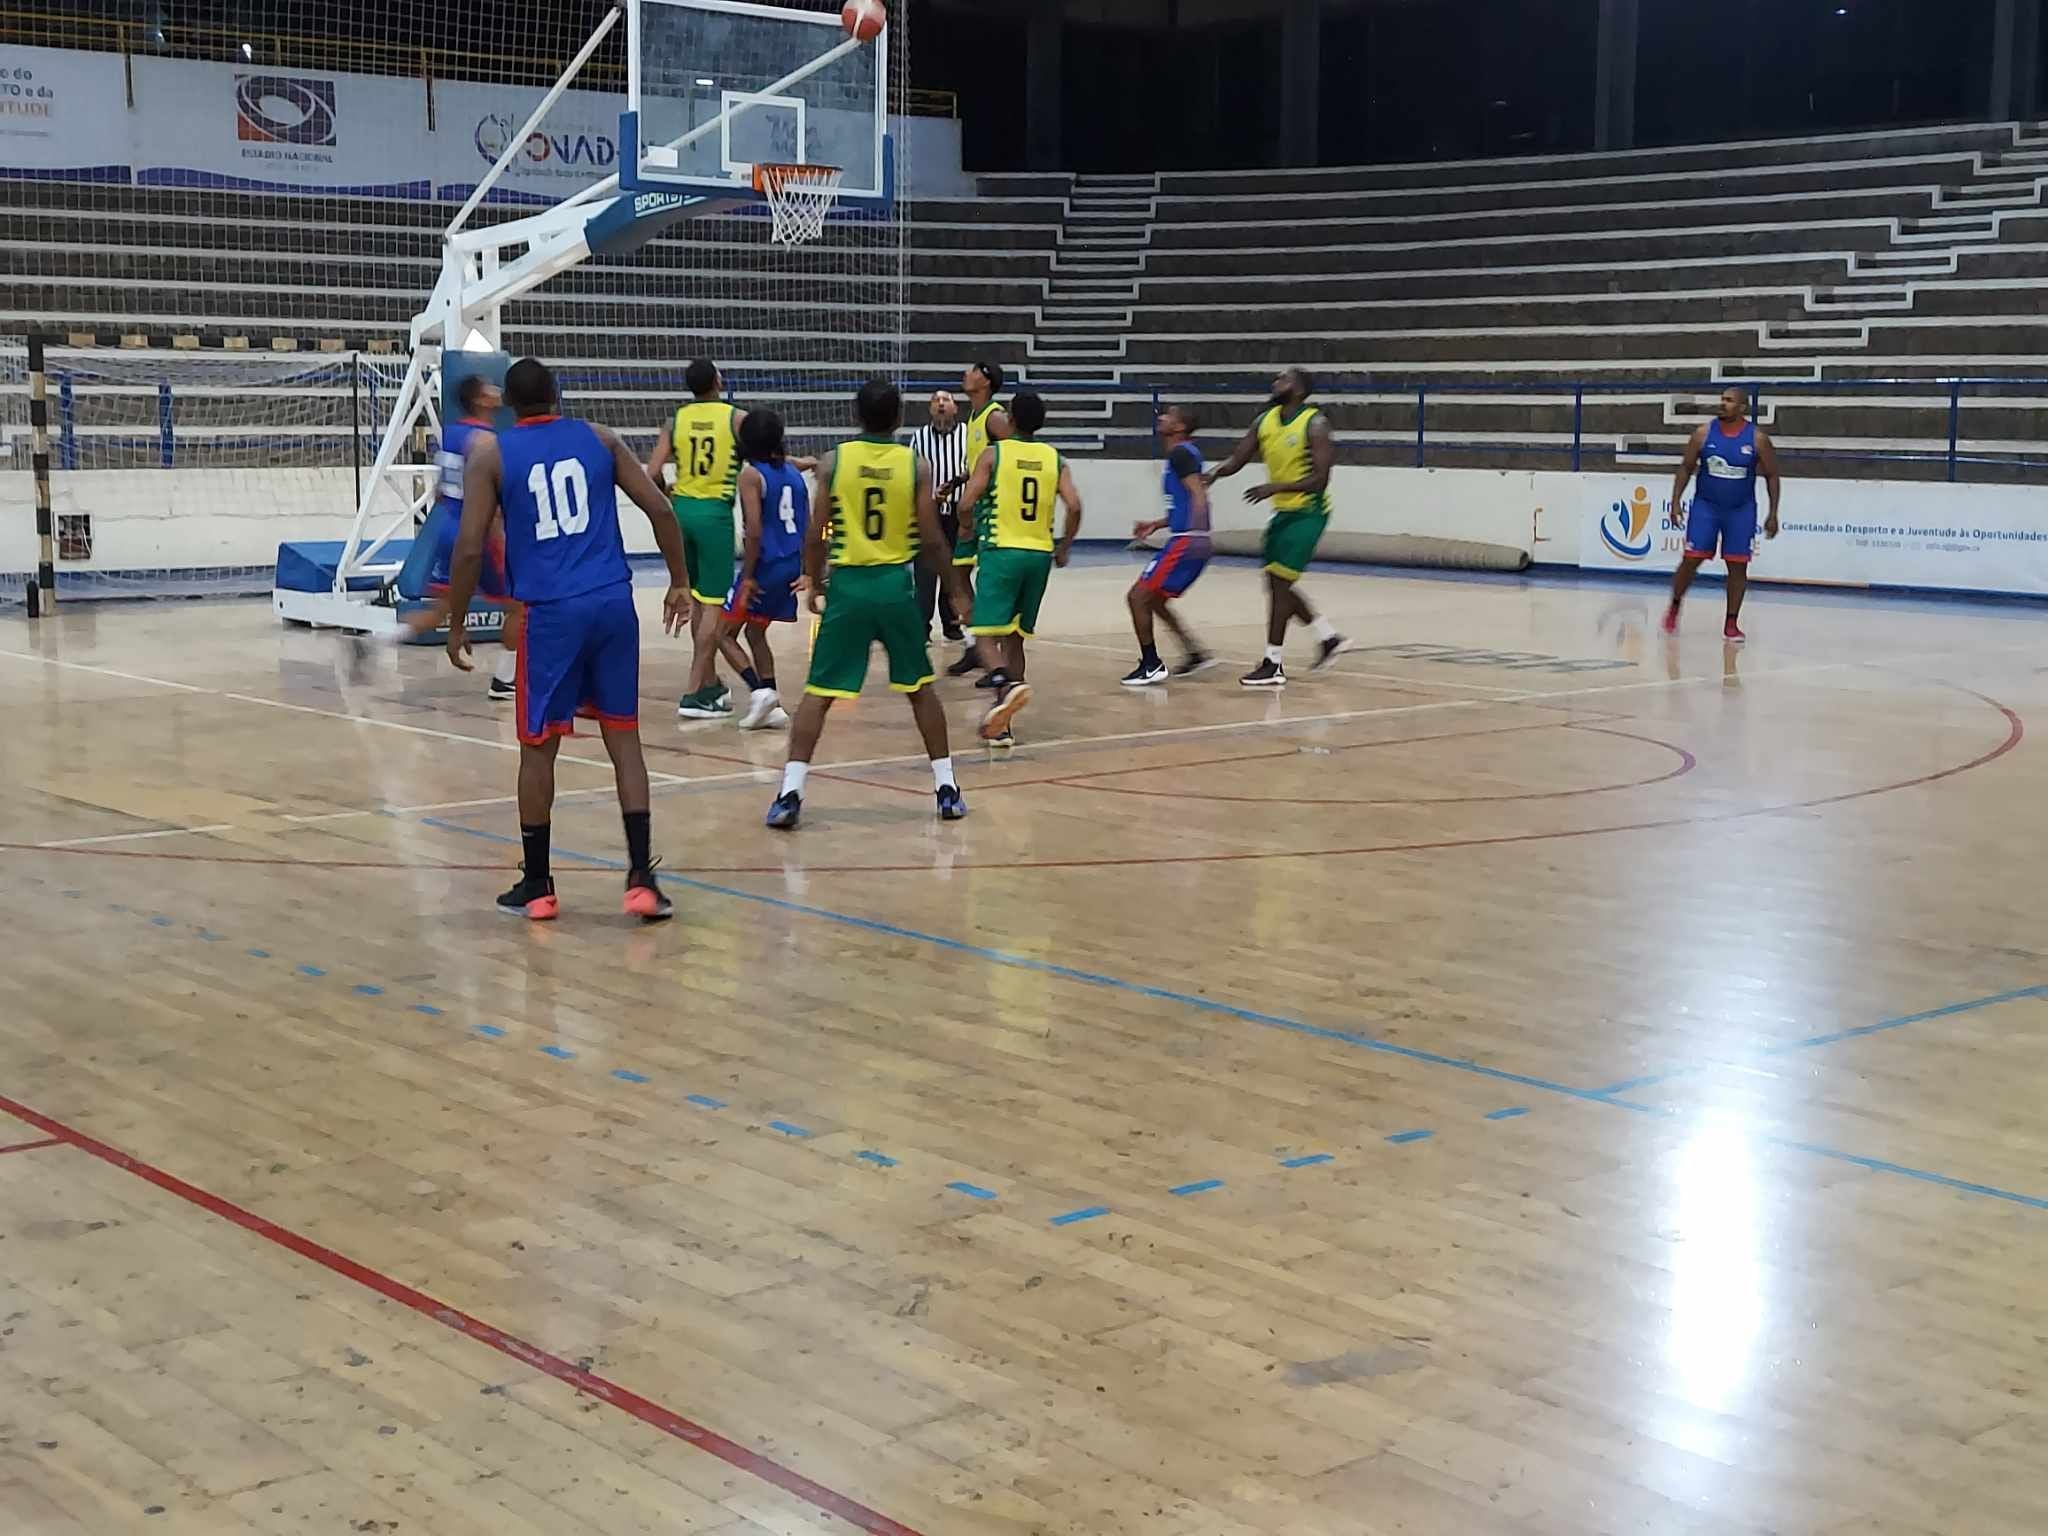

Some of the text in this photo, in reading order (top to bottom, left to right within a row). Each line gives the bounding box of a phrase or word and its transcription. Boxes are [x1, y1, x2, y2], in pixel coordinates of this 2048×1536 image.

[13, 67, 33, 80] do
[689, 435, 715, 477] 13
[528, 457, 591, 541] 10
[778, 485, 795, 534] 4
[865, 486, 885, 541] 6
[1021, 476, 1038, 522] 9
[1781, 522, 1836, 533] Conectando
[1845, 523, 1889, 535] Desporto
[1907, 526, 1957, 538] Juventude
[1972, 528, 2048, 542] Oportunidades
